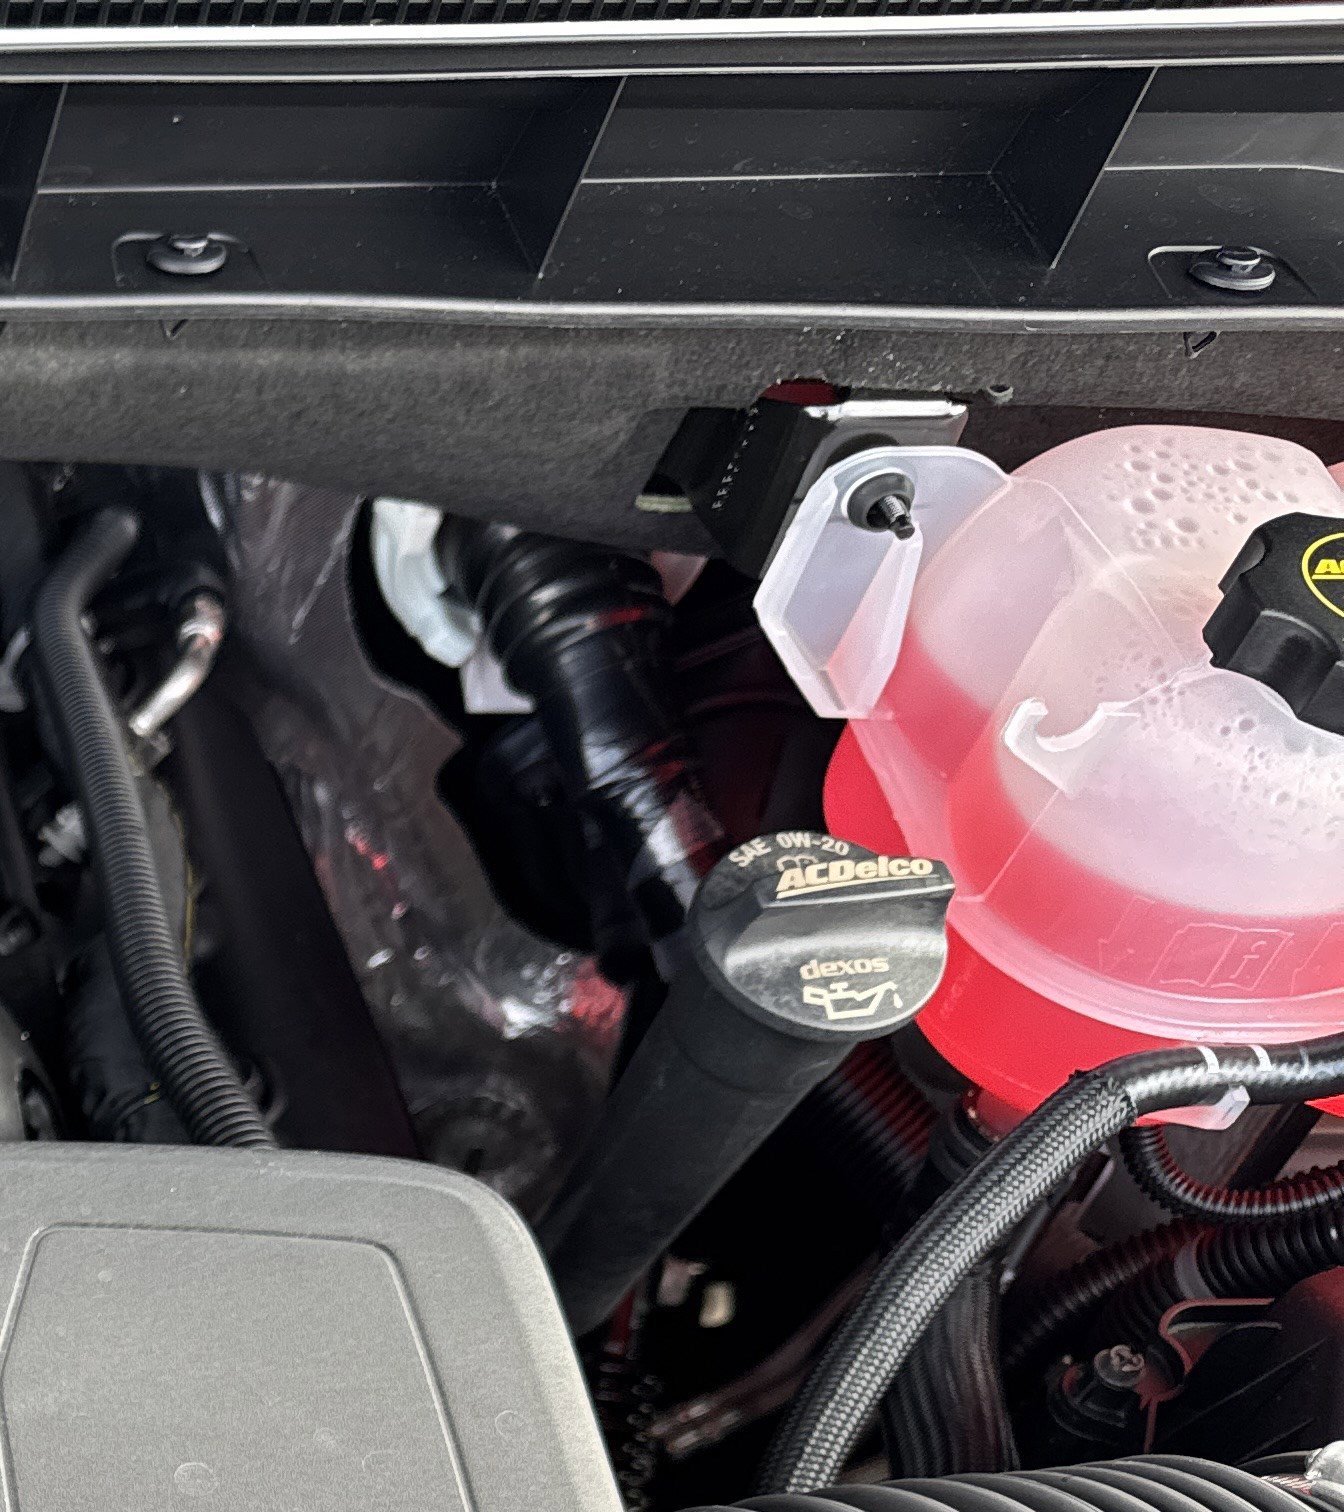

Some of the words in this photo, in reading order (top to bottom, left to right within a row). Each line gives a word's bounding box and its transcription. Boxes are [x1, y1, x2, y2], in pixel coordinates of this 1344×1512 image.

[728, 837, 772, 868] SAE
[775, 831, 850, 856] 0W-20
[775, 855, 934, 892] ACDelco
[799, 956, 890, 980] dexos
